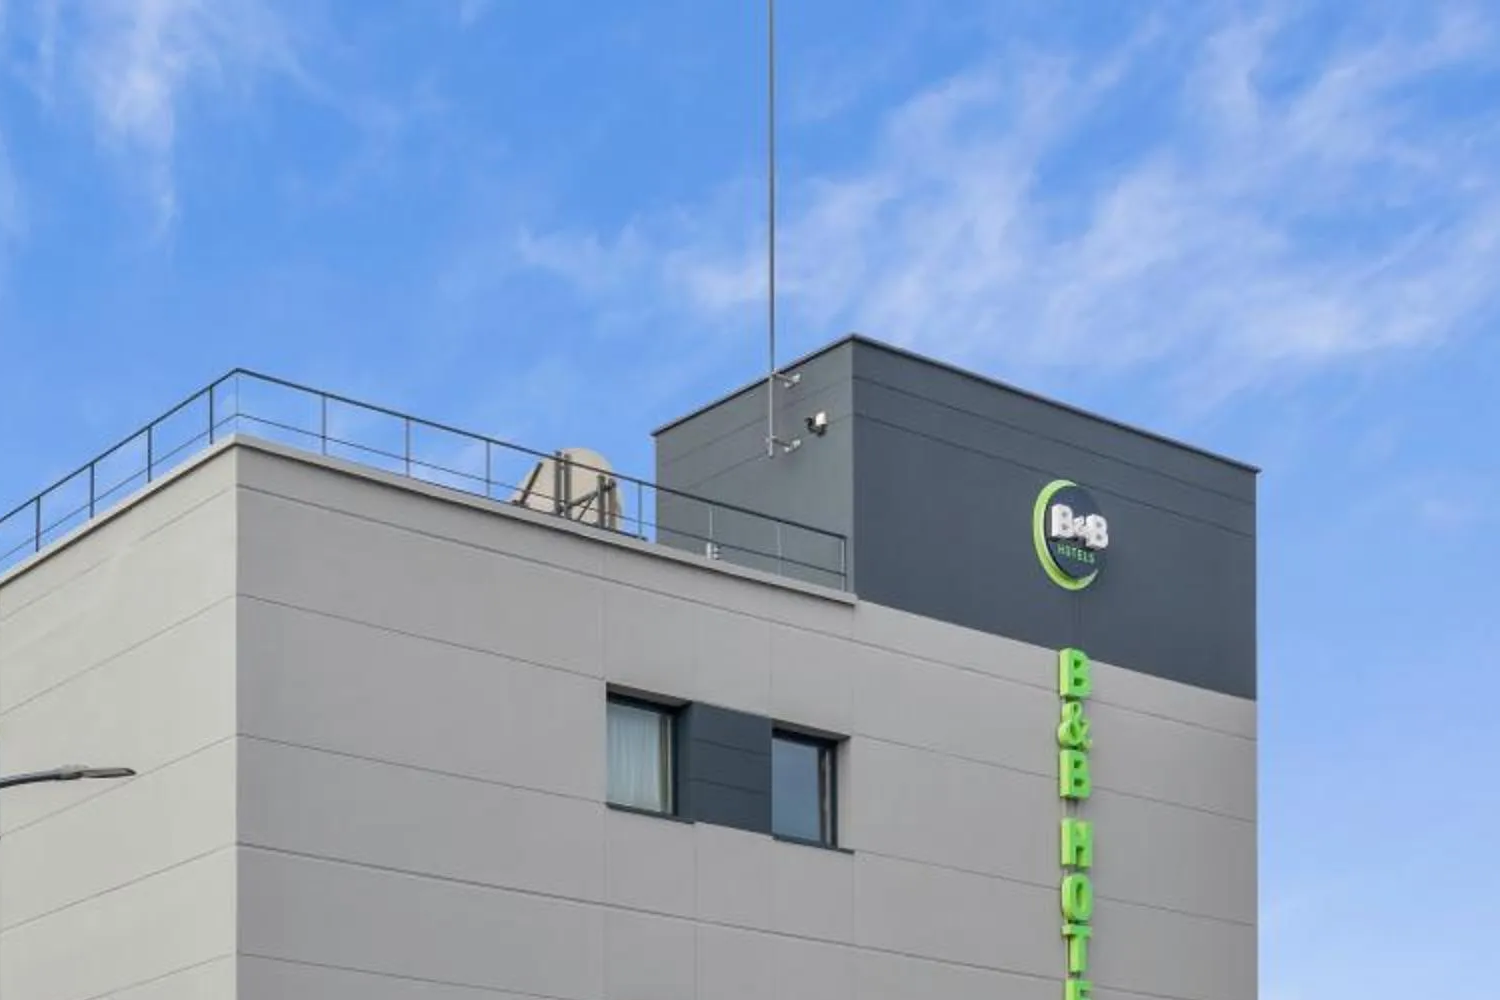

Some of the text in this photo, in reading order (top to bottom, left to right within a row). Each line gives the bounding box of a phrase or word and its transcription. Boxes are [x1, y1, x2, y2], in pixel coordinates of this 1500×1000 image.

[1051, 504, 1109, 549] B&B
[1057, 543, 1096, 564] HOTELS
[1057, 647, 1092, 800] B&B
